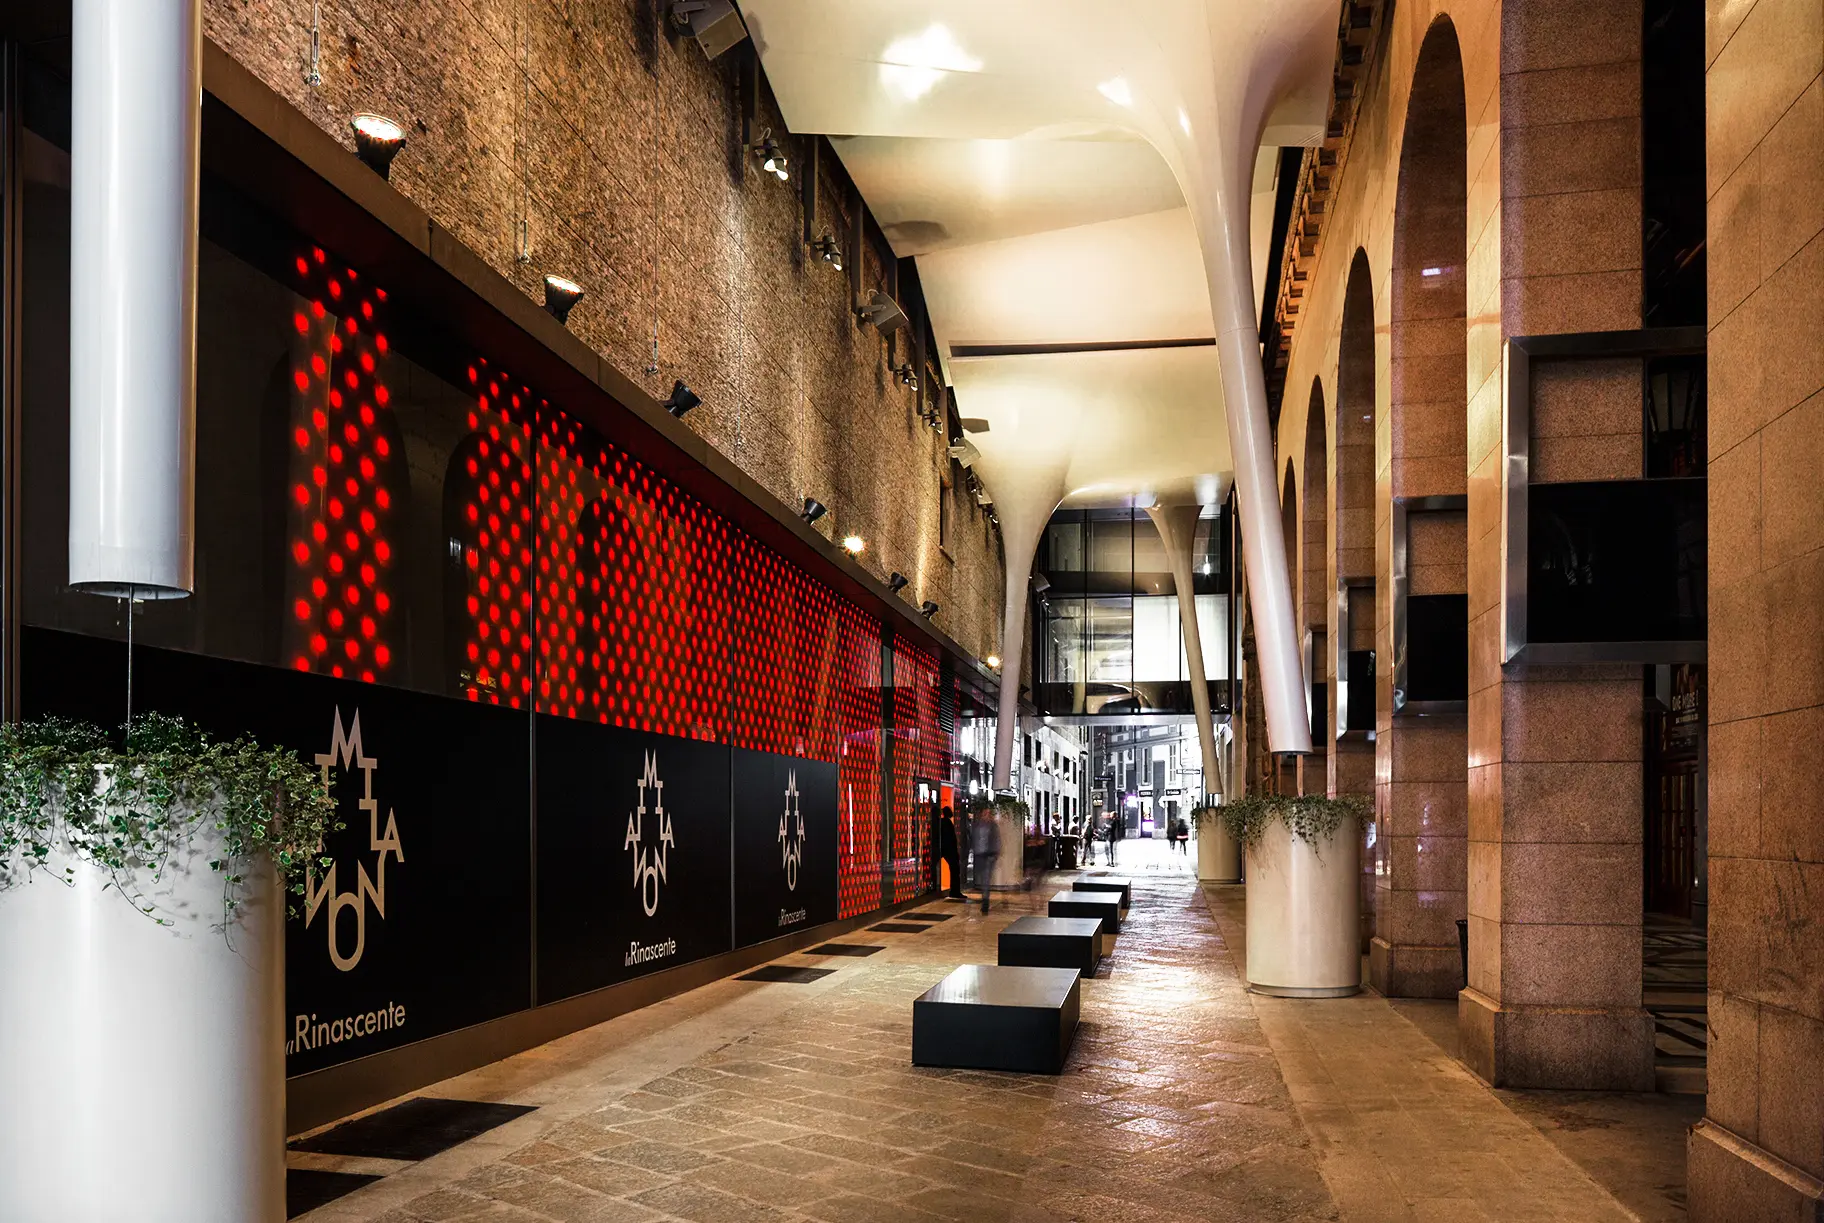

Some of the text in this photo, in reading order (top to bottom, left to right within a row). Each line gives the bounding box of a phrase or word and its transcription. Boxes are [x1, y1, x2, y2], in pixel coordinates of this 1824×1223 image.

[624, 747, 675, 917] MILANO
[777, 767, 806, 891] MILANO
[285, 1001, 406, 1055] aRinascente
